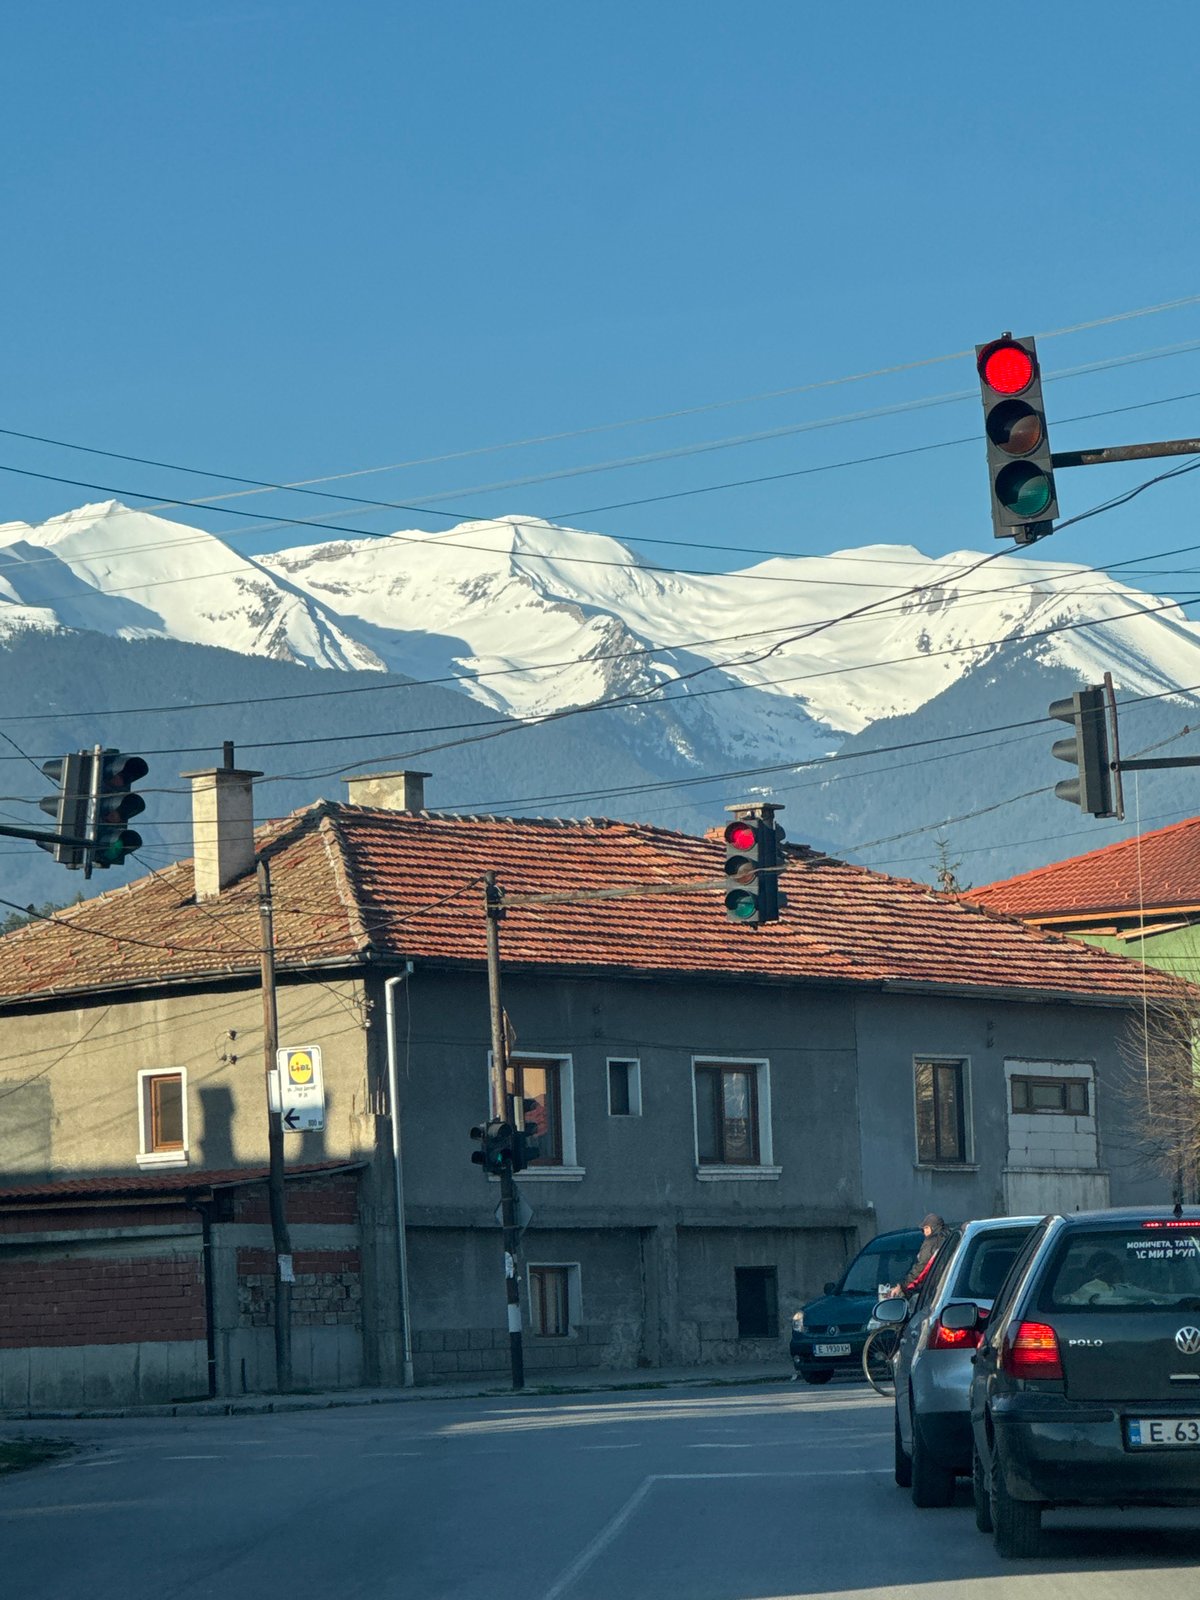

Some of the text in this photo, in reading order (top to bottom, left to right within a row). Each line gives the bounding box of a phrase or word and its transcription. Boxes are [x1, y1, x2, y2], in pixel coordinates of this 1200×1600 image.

[1126, 1240, 1173, 1249] МОМИЧЕТА,
[1148, 1250, 1164, 1259] МИ
[1165, 1249, 1173, 1258] Я
[1069, 1339, 1103, 1347] POLO
